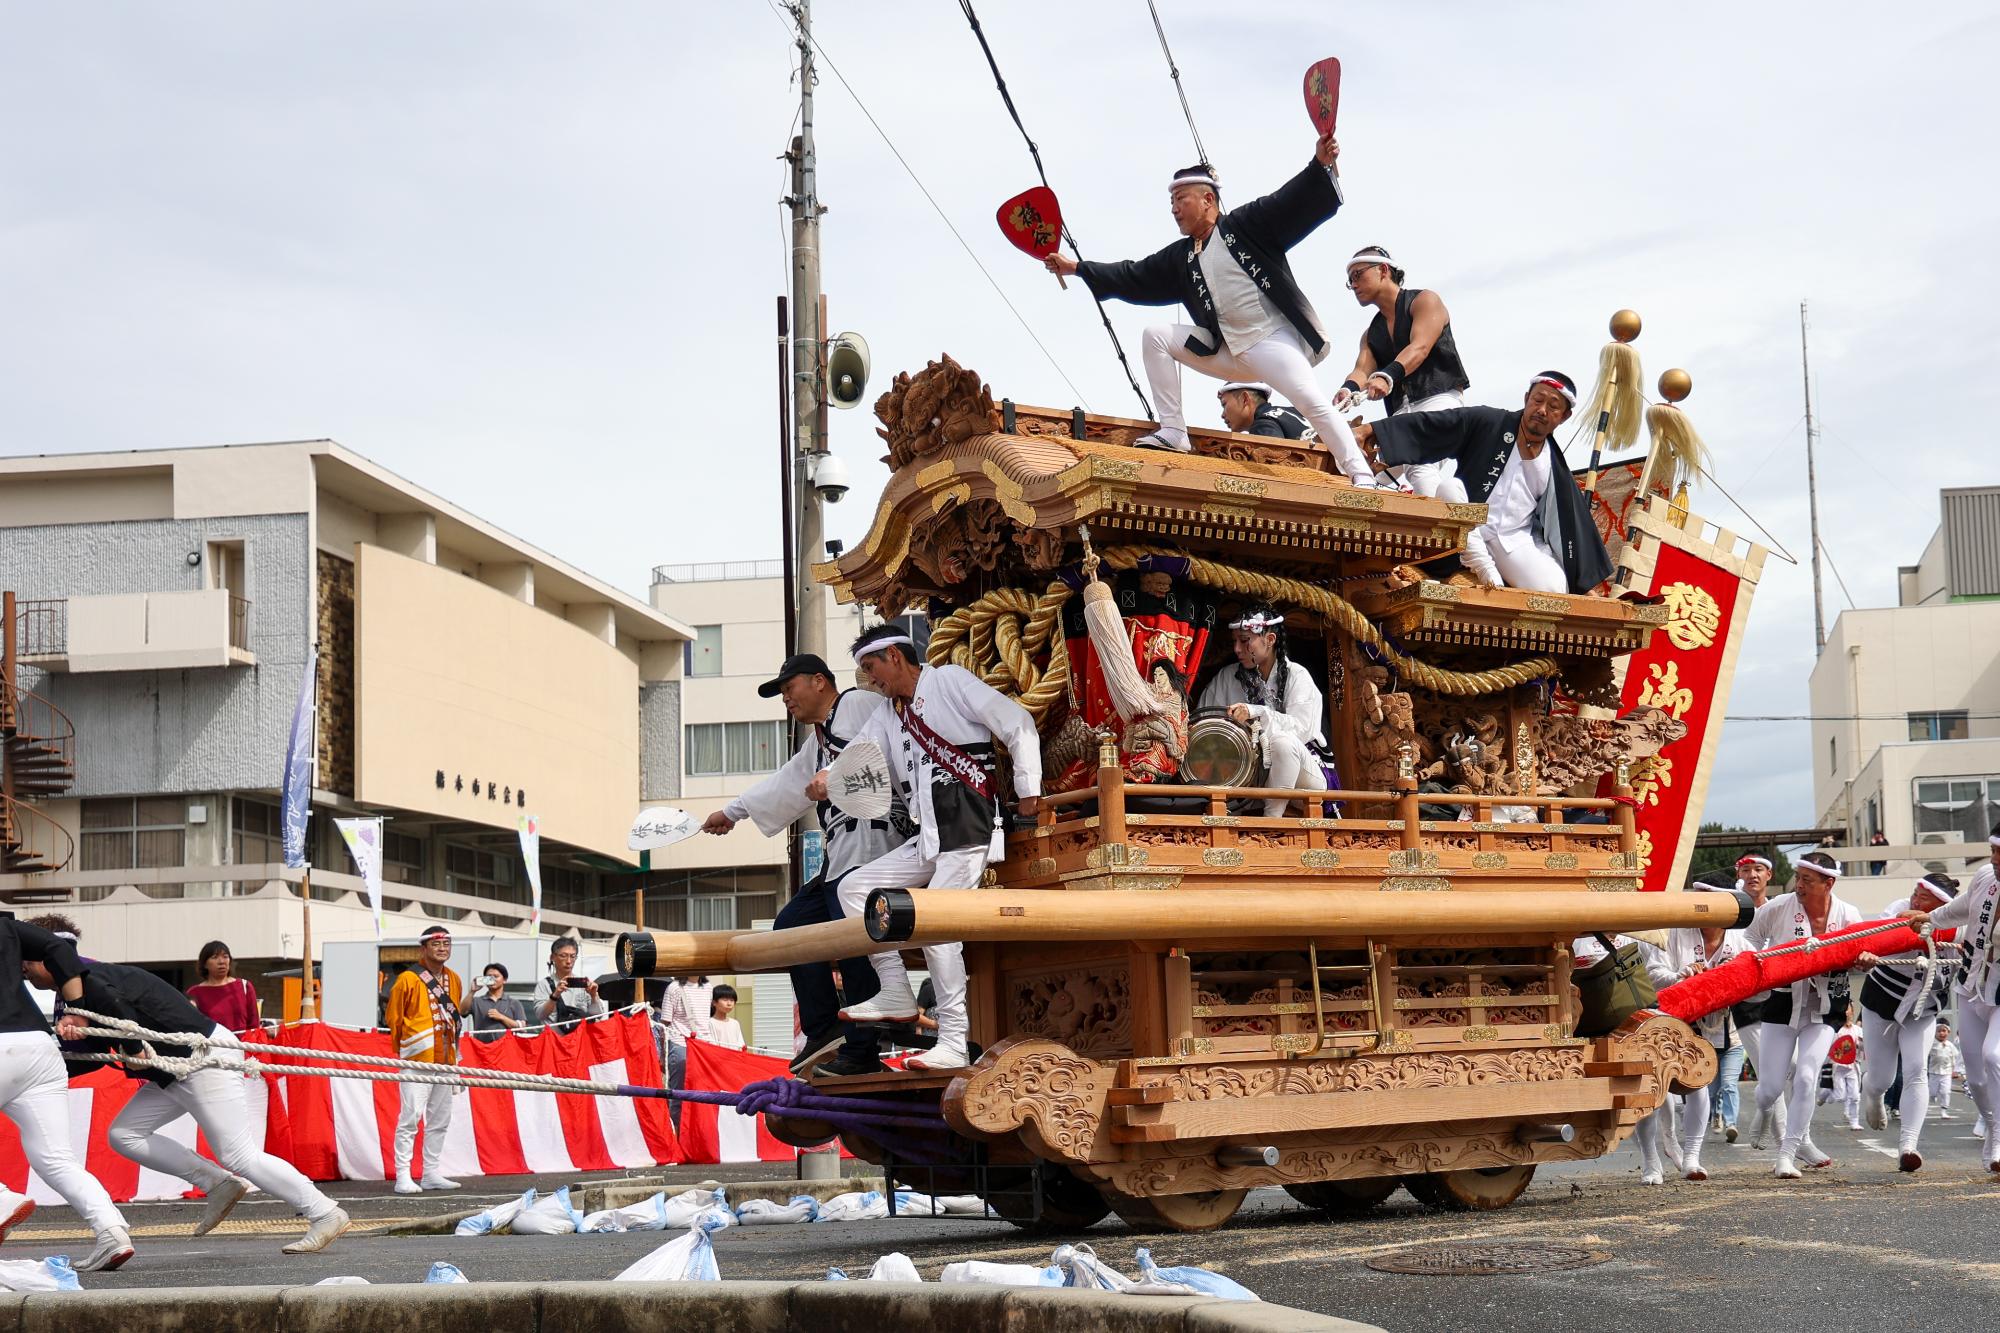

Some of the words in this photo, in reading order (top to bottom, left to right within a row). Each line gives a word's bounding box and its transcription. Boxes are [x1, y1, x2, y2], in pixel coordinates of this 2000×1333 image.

[1192, 270, 1212, 311] 大工方
[1237, 251, 1271, 290] 大工方
[1482, 450, 1506, 492] 大工方
[842, 764, 888, 796] 若頭
[1975, 899, 1993, 950] 拾伍人組
